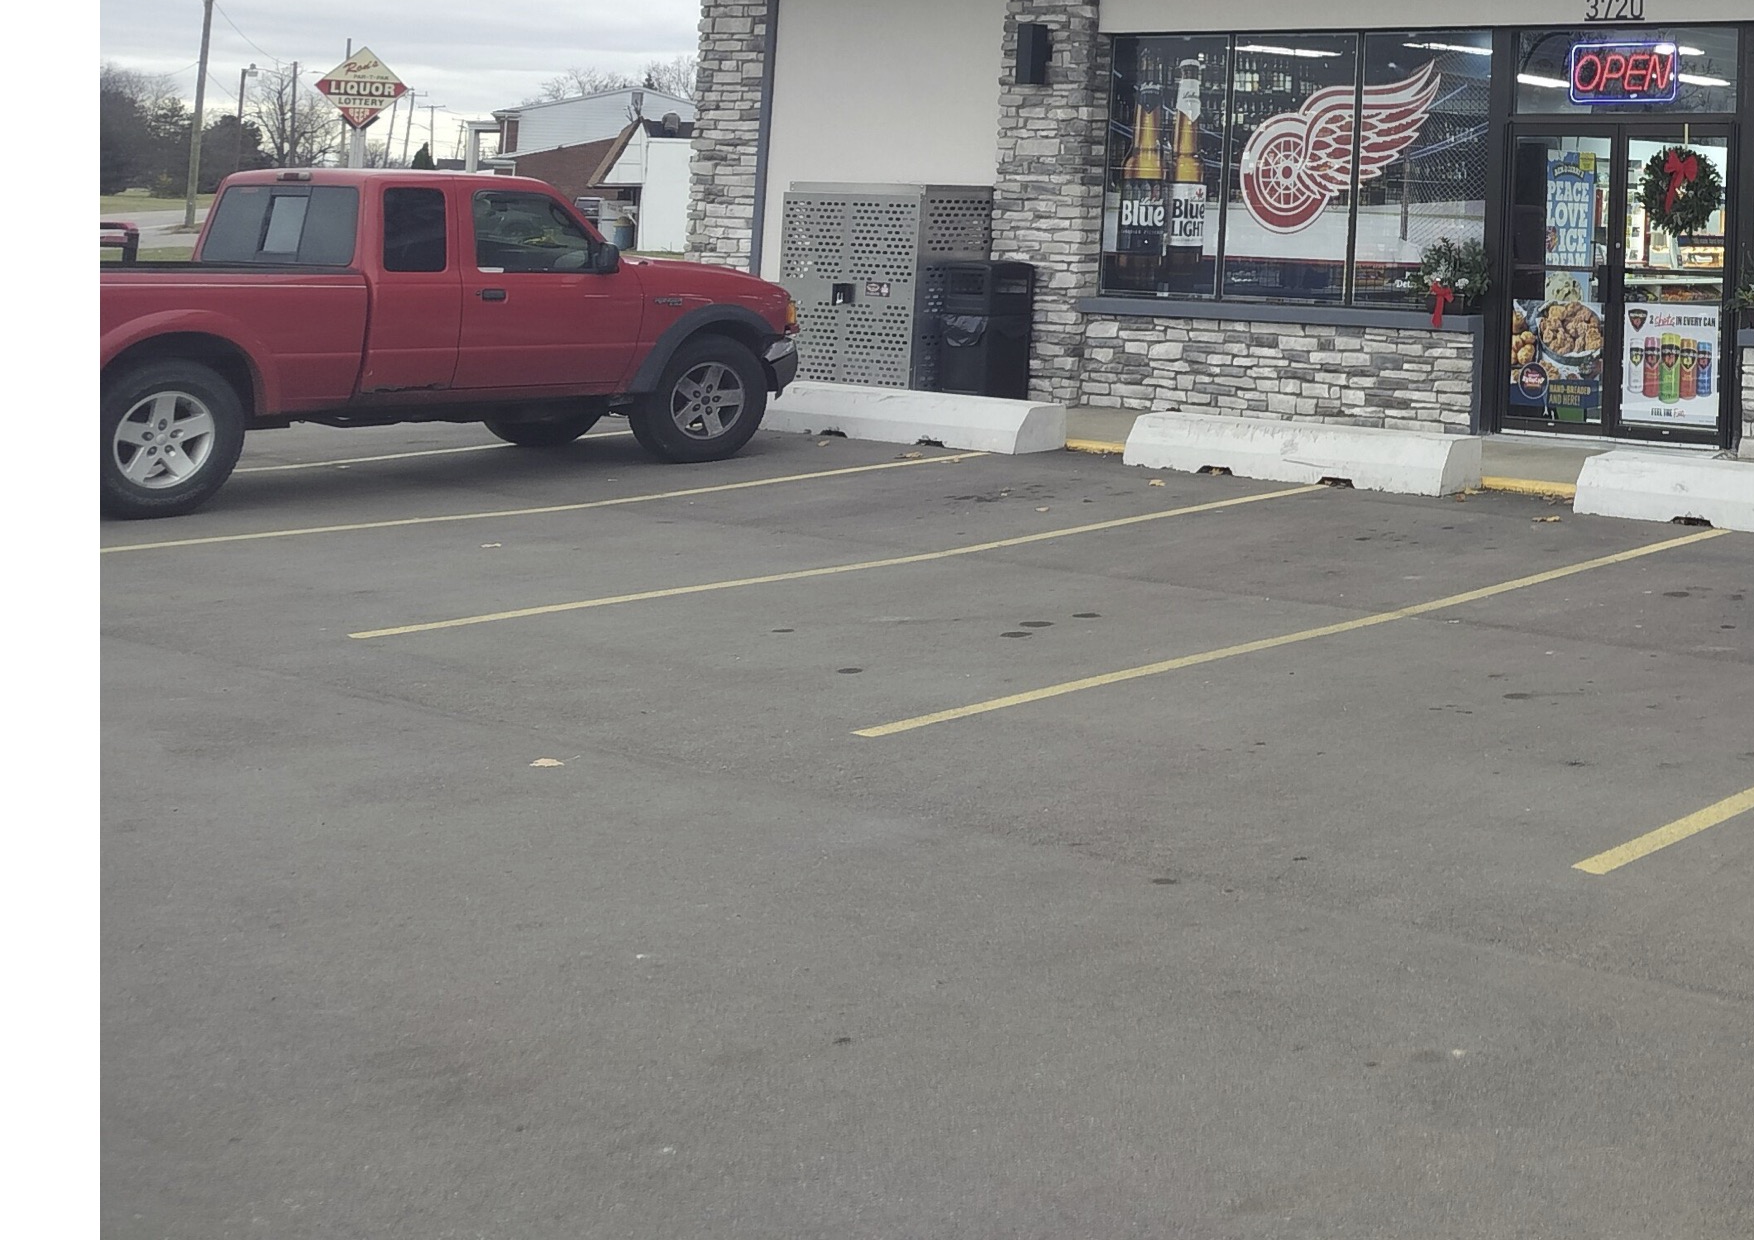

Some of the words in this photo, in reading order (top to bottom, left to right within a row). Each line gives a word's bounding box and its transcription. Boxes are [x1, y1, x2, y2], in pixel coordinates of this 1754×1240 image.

[1574, 53, 1674, 91] OPEN
[330, 80, 395, 96] LIQUOR
[338, 97, 384, 106] LOTTERY
[348, 108, 370, 122] BEER
[1547, 180, 1589, 202] PEACE
[1121, 199, 1165, 227] Blue
[1172, 198, 1205, 220] Blue
[1546, 201, 1588, 228] LOVE
[1171, 220, 1204, 237] LIGHT
[1558, 227, 1587, 252] ICE
[1683, 316, 1702, 327] EVERY
[1703, 317, 1716, 327] CAN
[1549, 393, 1562, 405] AND
